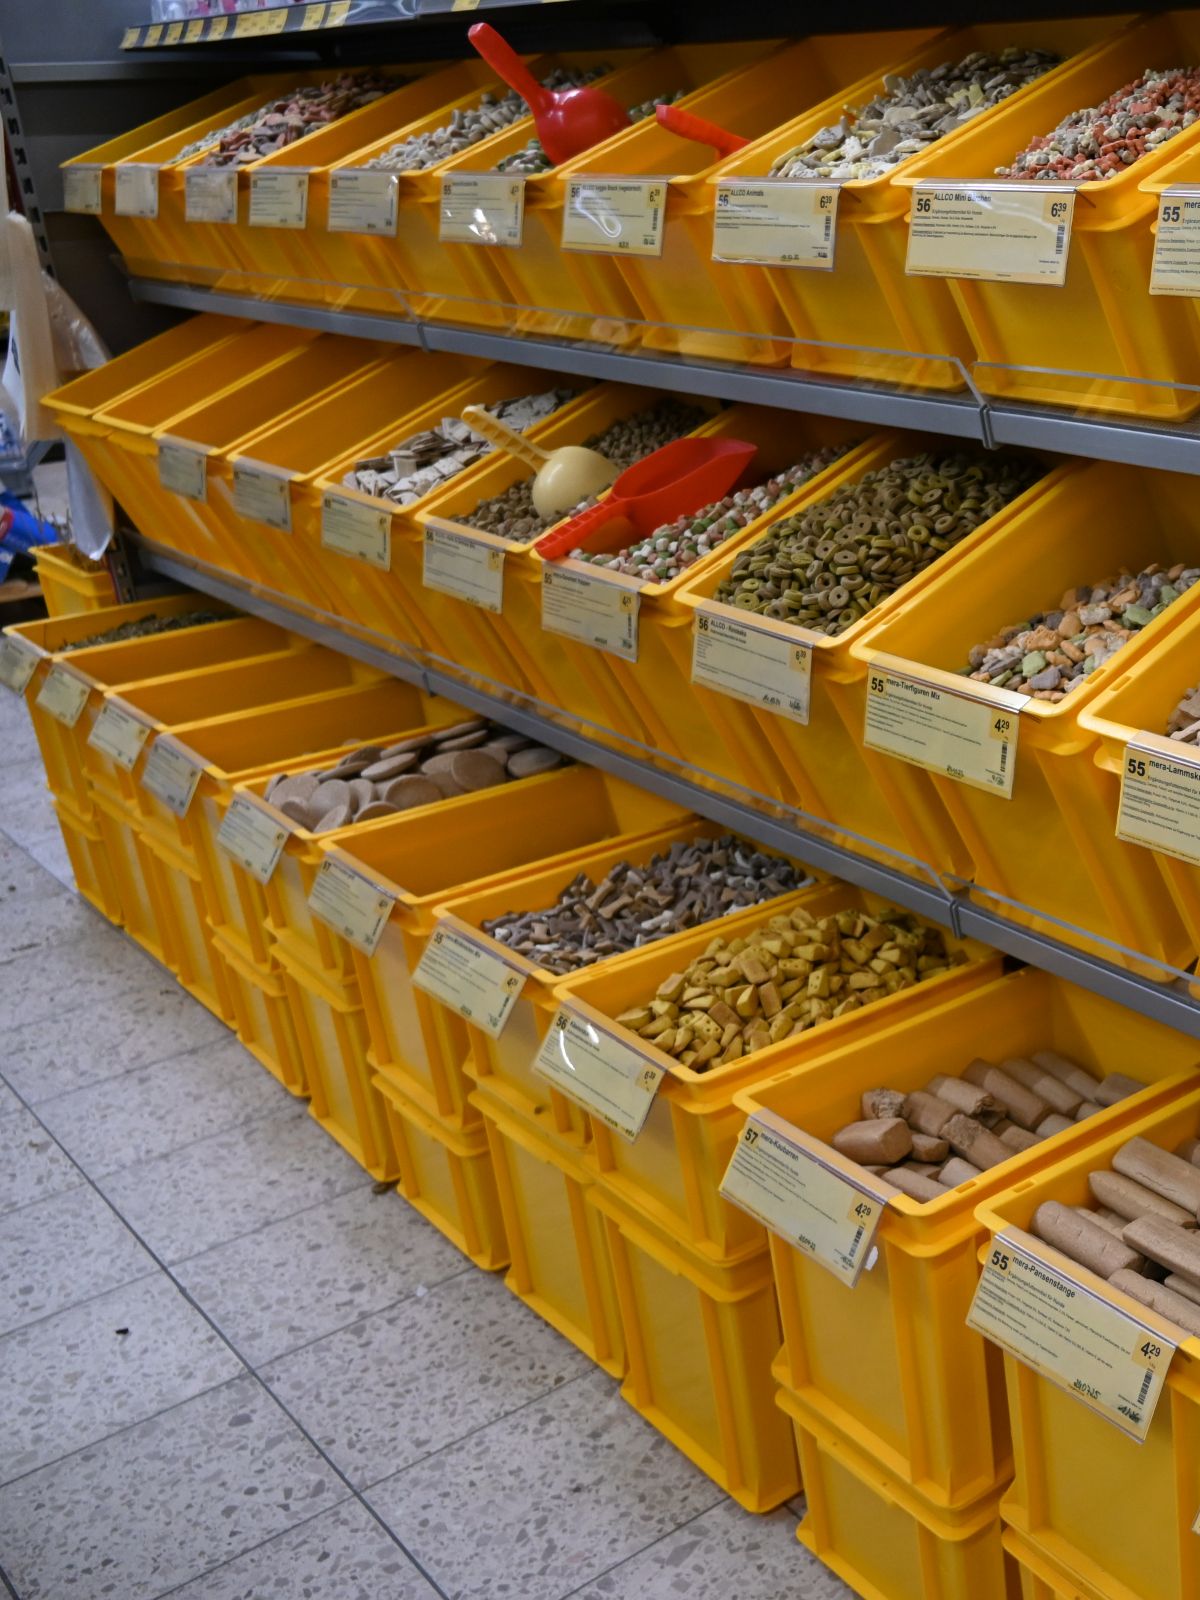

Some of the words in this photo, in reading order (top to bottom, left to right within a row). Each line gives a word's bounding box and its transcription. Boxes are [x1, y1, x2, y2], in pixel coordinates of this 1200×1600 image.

[819, 195, 832, 208] 6.39
[916, 198, 931, 212] 56
[933, 193, 954, 201] ALLCO
[954, 193, 967, 201] Mini
[1050, 202, 1067, 218] 6.39
[1162, 206, 1181, 223] 55
[699, 617, 708, 631] 56
[710, 619, 725, 630] ALLCO
[871, 677, 884, 693] 55
[885, 678, 930, 697] mera-Tierfiguren
[930, 691, 940, 700] Mix
[994, 718, 1010, 734] 4.29
[1127, 758, 1146, 777] 55
[556, 1015, 568, 1030] 56
[744, 1127, 759, 1145] 57
[854, 1202, 872, 1219] 4.29
[991, 1250, 1010, 1271] 55
[1012, 1256, 1076, 1298] mera-Pansenstange
[1140, 1341, 1161, 1360] 4.29
